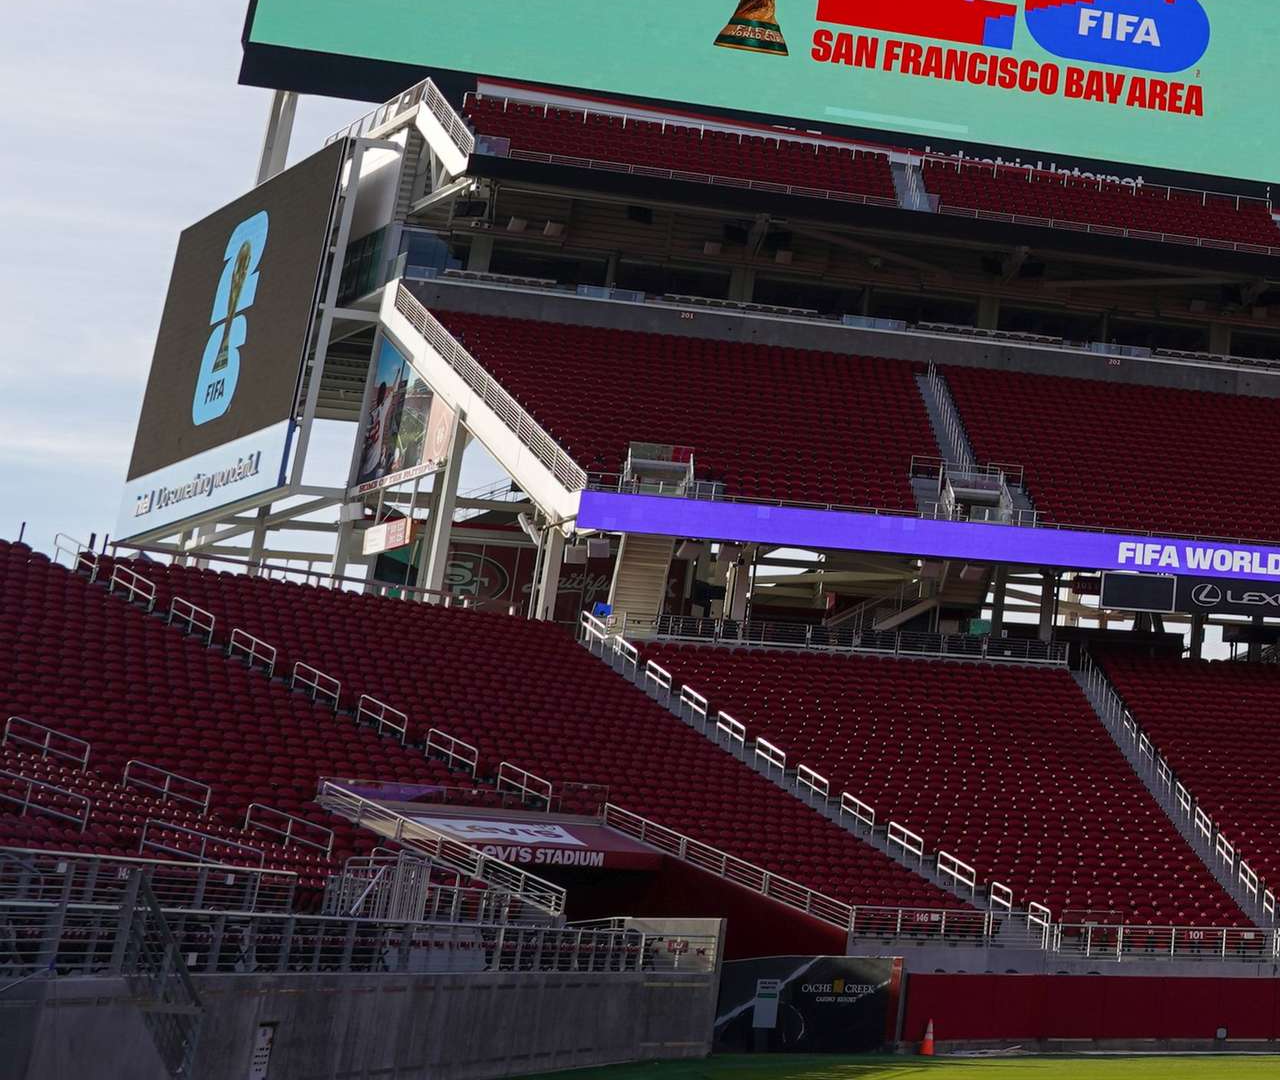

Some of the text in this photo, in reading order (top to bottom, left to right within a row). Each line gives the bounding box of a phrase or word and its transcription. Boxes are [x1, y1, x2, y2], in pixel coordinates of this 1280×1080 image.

[1078, 7, 1161, 47] FIFA
[811, 28, 1204, 117] SAN FRANCISCO BAY AREA
[204, 378, 225, 405] FIFA
[1117, 542, 1180, 568] FIFA
[534, 848, 605, 867] STADIUM
[1190, 930, 1203, 939] 101
[801, 983, 875, 993] CACHE CREEK
